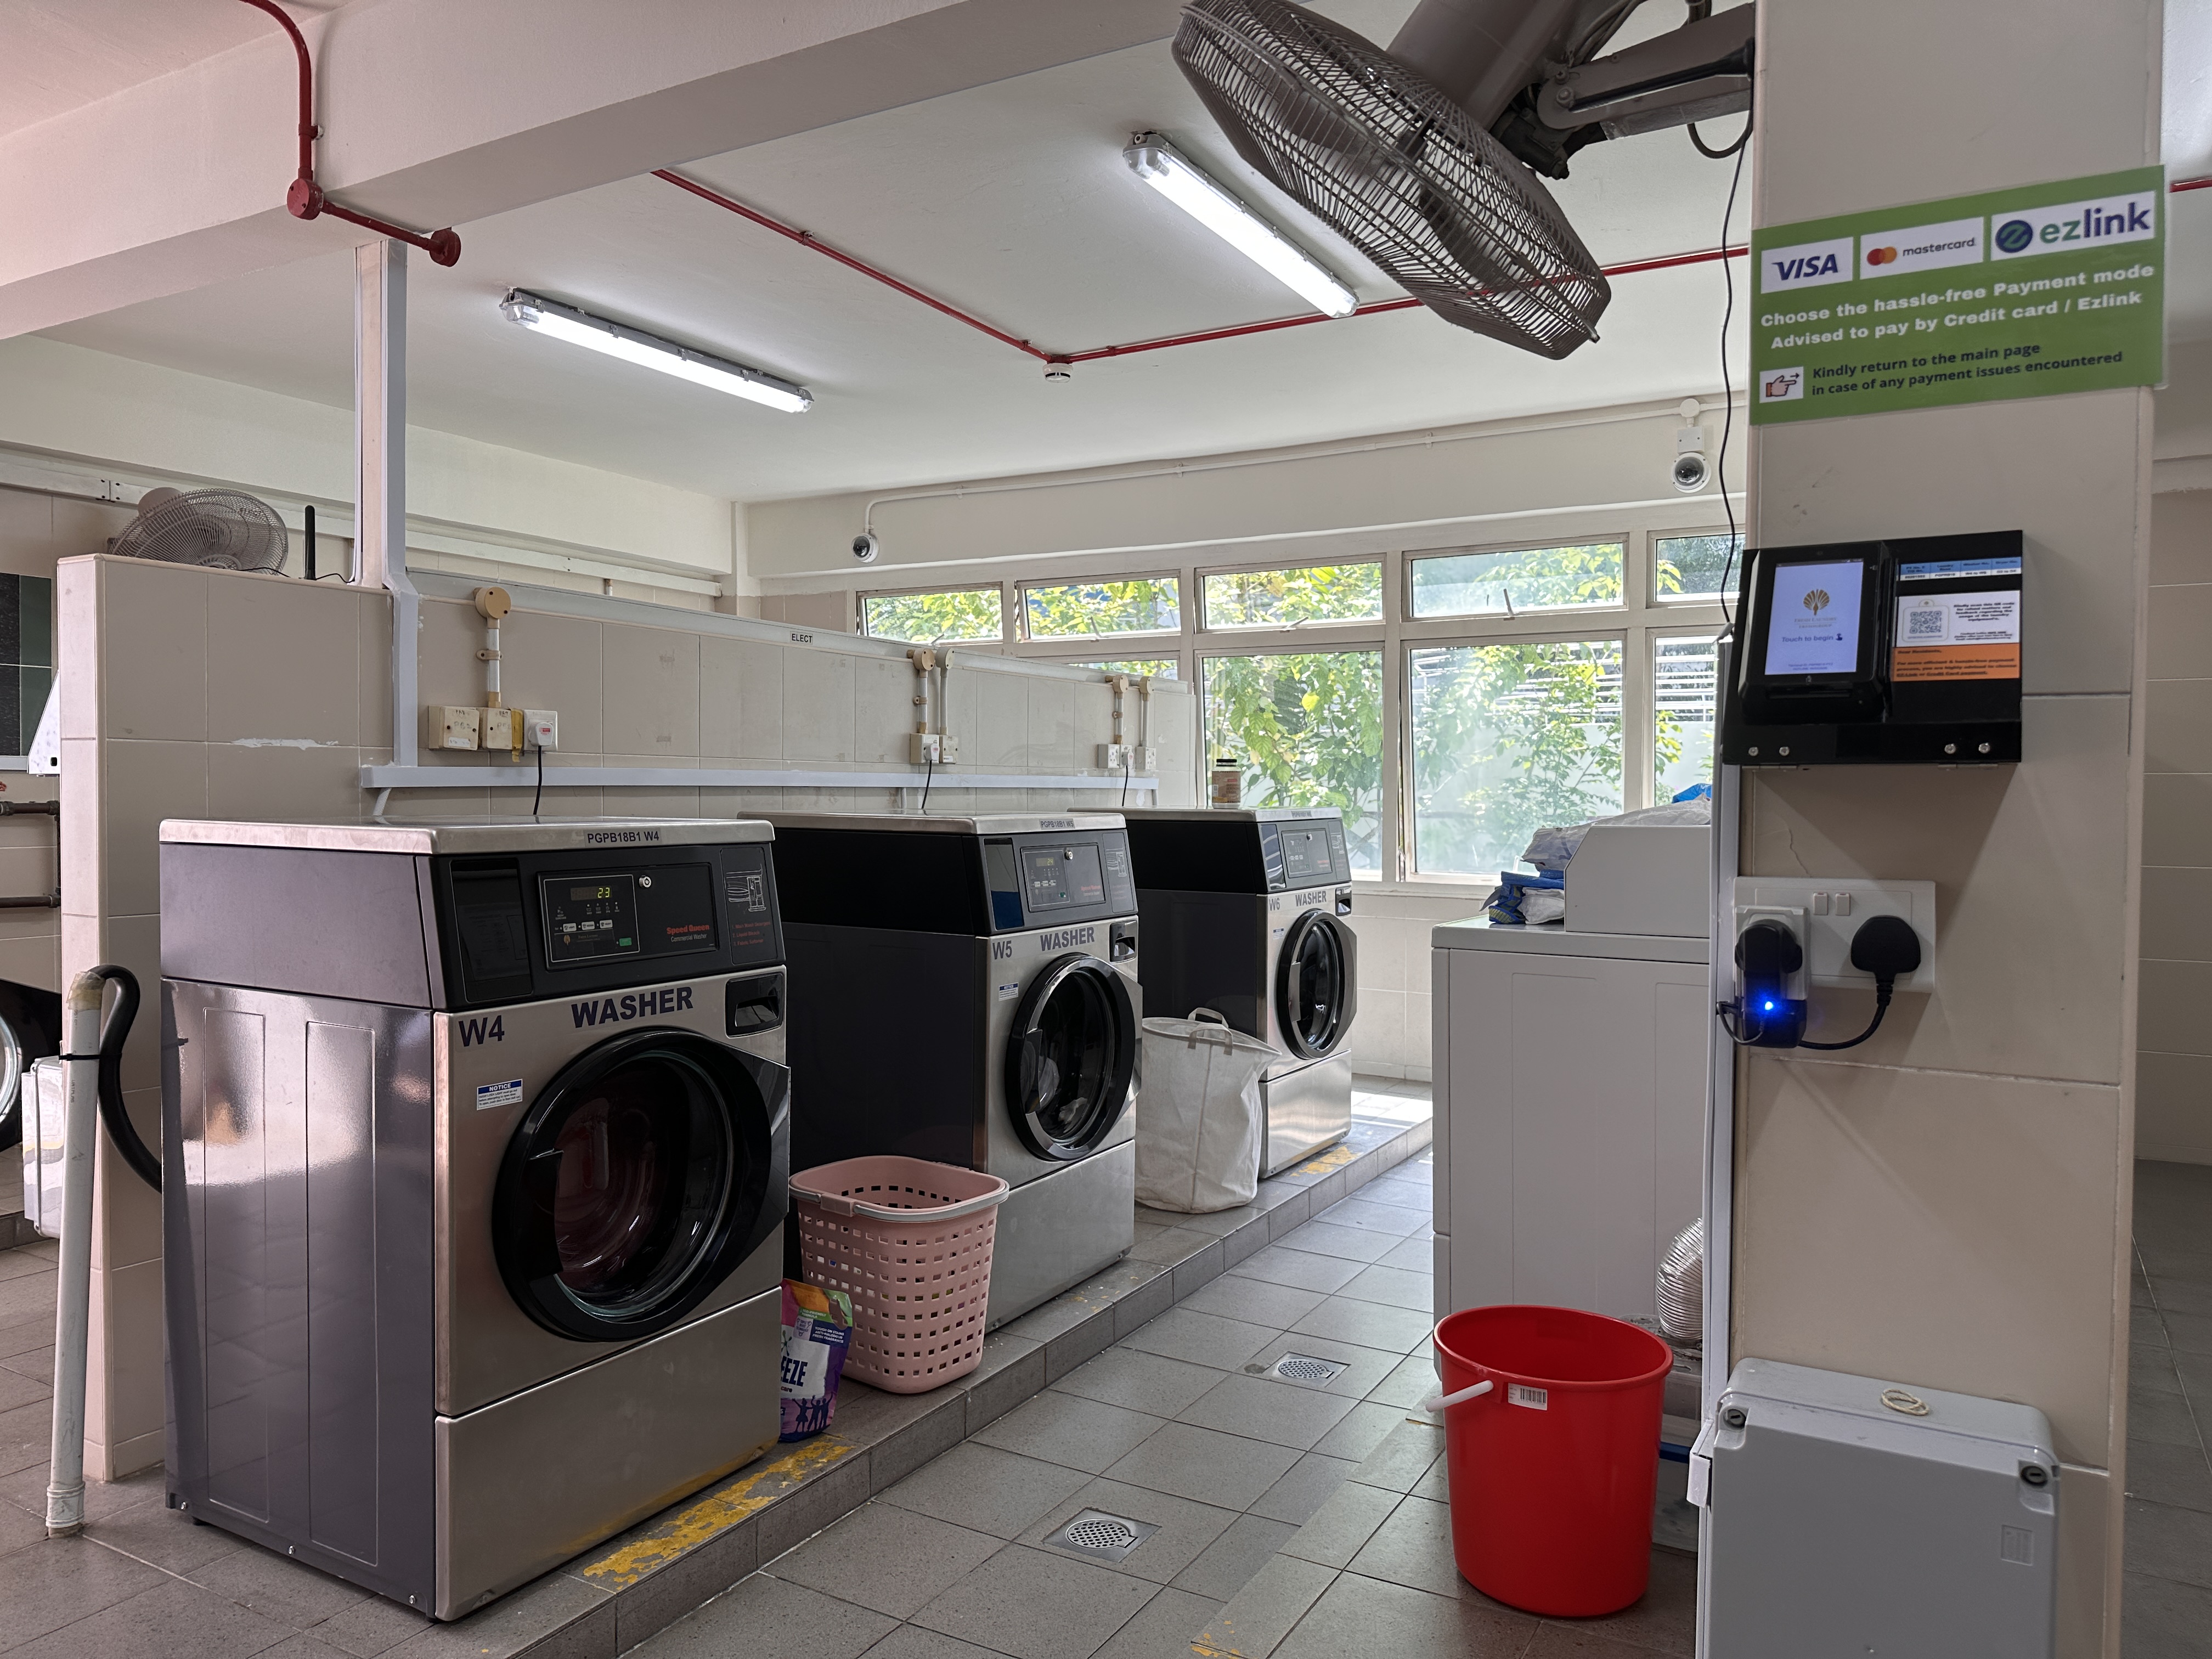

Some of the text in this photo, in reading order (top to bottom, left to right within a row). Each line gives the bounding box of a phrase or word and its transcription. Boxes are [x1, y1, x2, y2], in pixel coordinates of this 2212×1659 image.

[2039, 202, 2151, 243] ezlink
[1903, 238, 1975, 257] mastercard
[1771, 253, 1838, 281] VISA
[1760, 264, 2155, 326] Choose the hassle-free Payment mode
[1771, 291, 2142, 349] Advised to pay by Credit card / Ezlink
[1813, 344, 2040, 379] Kindly return to the main page
[1812, 351, 2122, 396] in case of any payment issues encountered
[792, 634, 812, 643] ELECT
[588, 831, 659, 843] PGPB18B1 W4
[597, 887, 610, 898] 23
[1295, 891, 1327, 907] WASHER
[1269, 898, 1280, 911] W6
[667, 926, 688, 935] Speed
[1040, 927, 1094, 951] WASHER
[992, 940, 1012, 960] W5
[571, 986, 693, 1029] WASHER
[458, 1015, 505, 1048] W4
[489, 1083, 511, 1092] NOTICE
